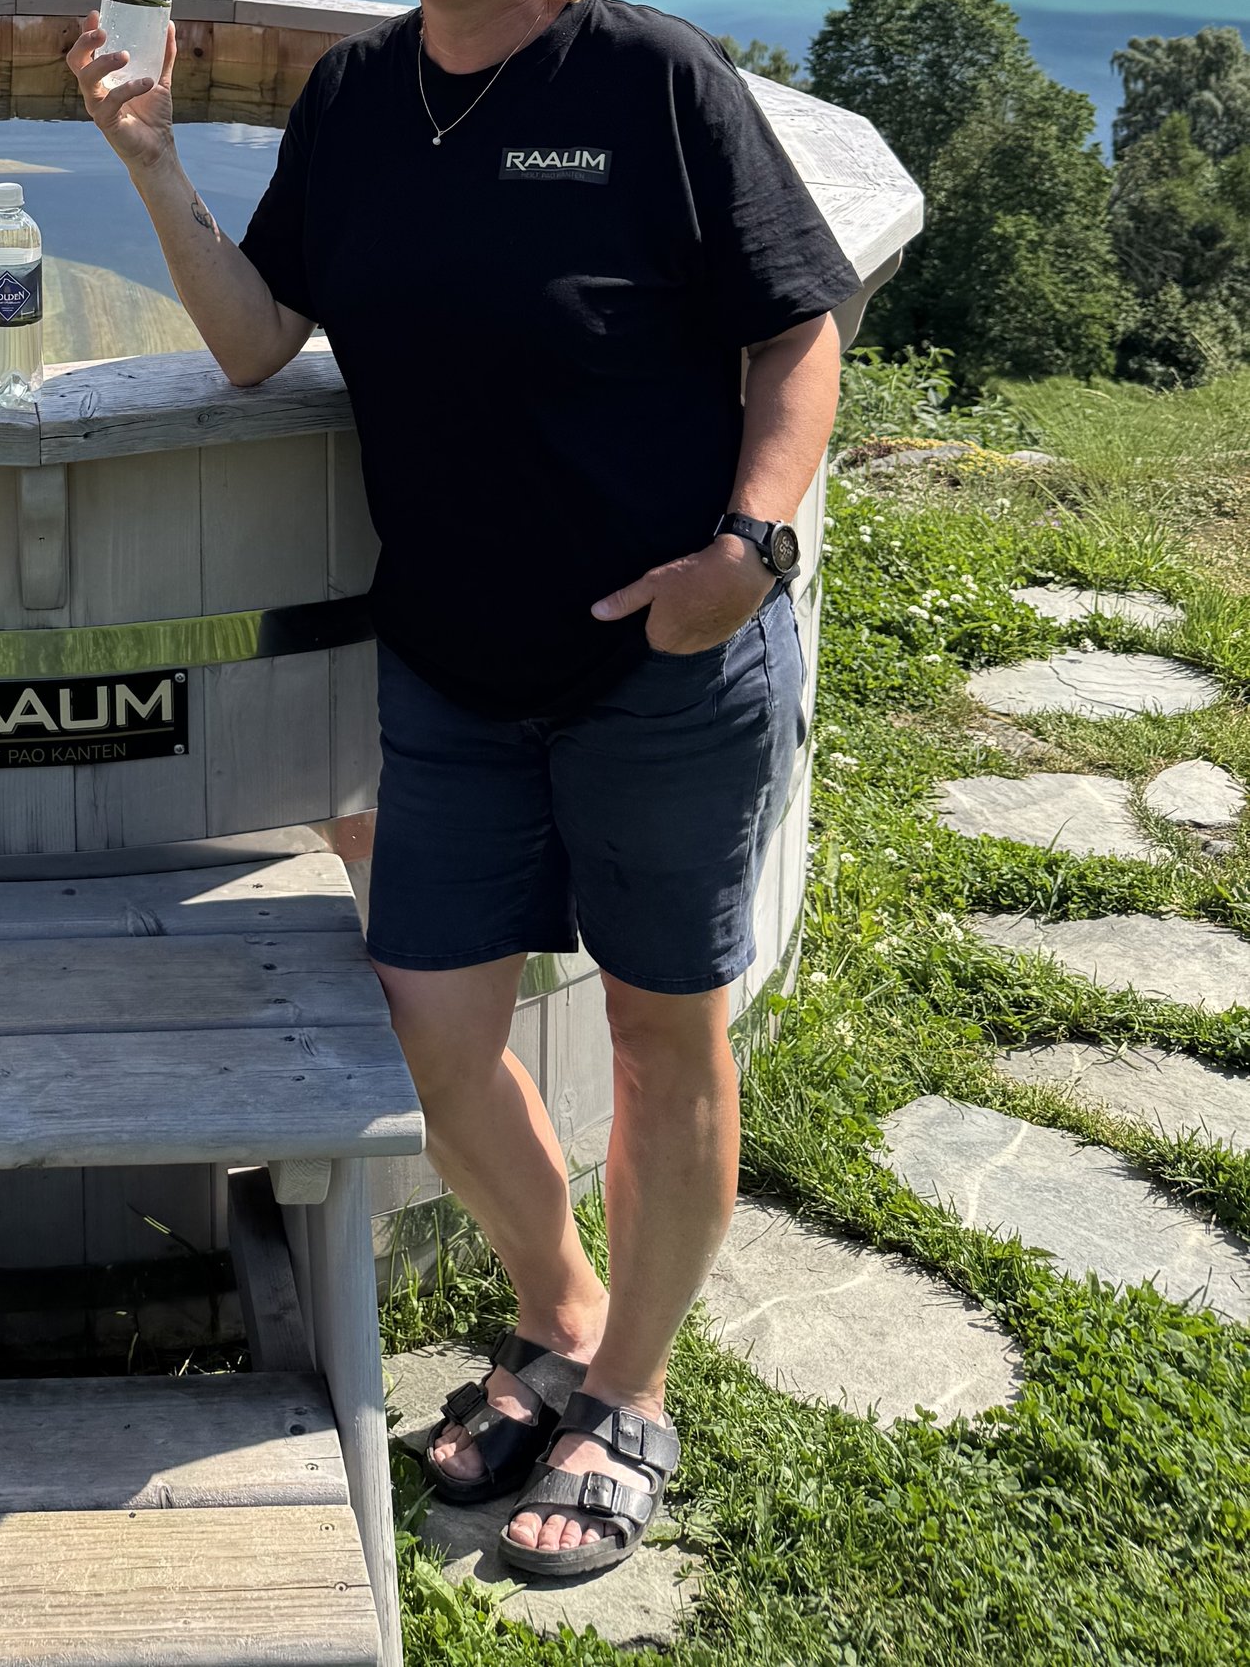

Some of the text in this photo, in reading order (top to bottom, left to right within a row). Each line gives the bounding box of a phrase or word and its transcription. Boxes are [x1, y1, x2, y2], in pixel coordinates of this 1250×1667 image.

[506, 150, 606, 171] RAAUM
[9, 748, 45, 764] PAO
[52, 743, 126, 762] KANTEN
